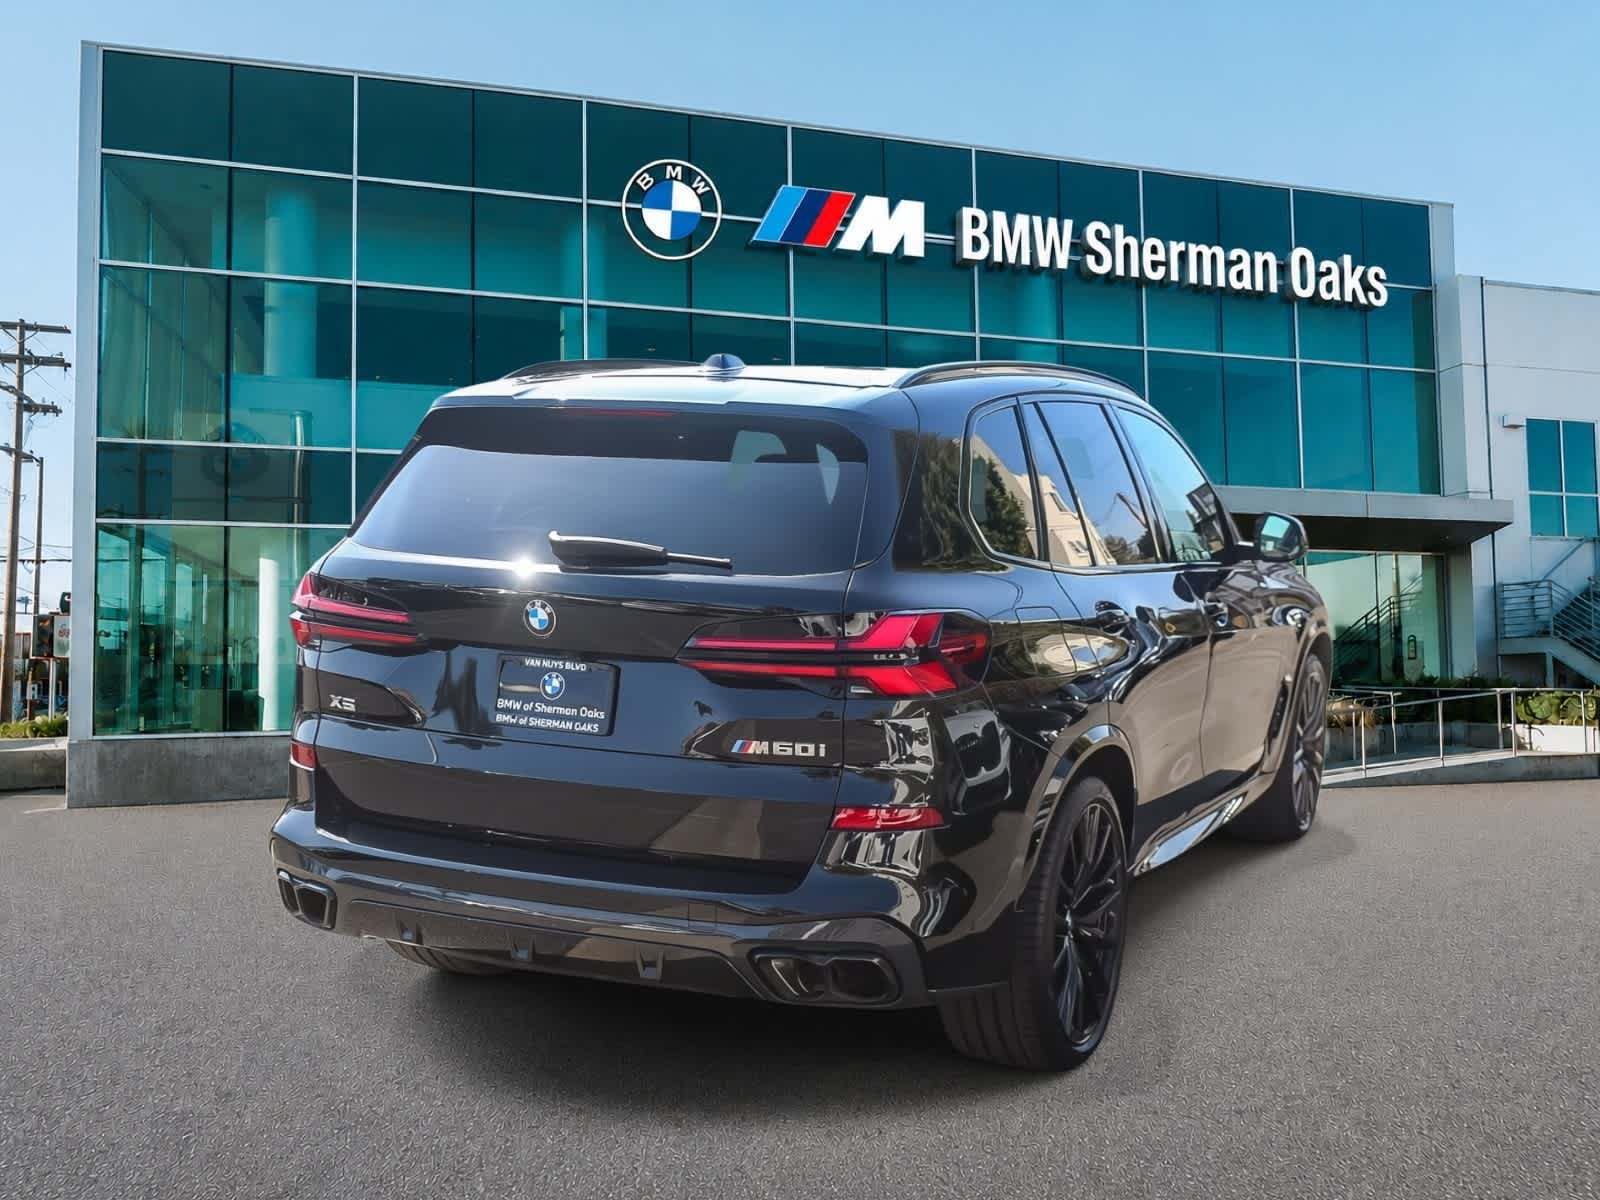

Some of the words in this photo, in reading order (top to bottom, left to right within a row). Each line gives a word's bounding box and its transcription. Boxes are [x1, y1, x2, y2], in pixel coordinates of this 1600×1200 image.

[959, 206, 1073, 270] BMW
[1084, 221, 1279, 294] Sherman
[1290, 246, 1388, 307] Oaks
[525, 658, 541, 667] VAN
[542, 659, 564, 669] NUYS
[565, 662, 587, 671] BLVD
[329, 694, 356, 712] X5
[497, 698, 521, 711] BMW
[523, 702, 534, 711] of
[535, 703, 577, 715] Sherman
[580, 706, 605, 719] Oaks
[496, 714, 517, 723] BMW
[519, 716, 528, 725] of
[529, 717, 572, 730] SHERMAN
[574, 721, 599, 733] OAKS
